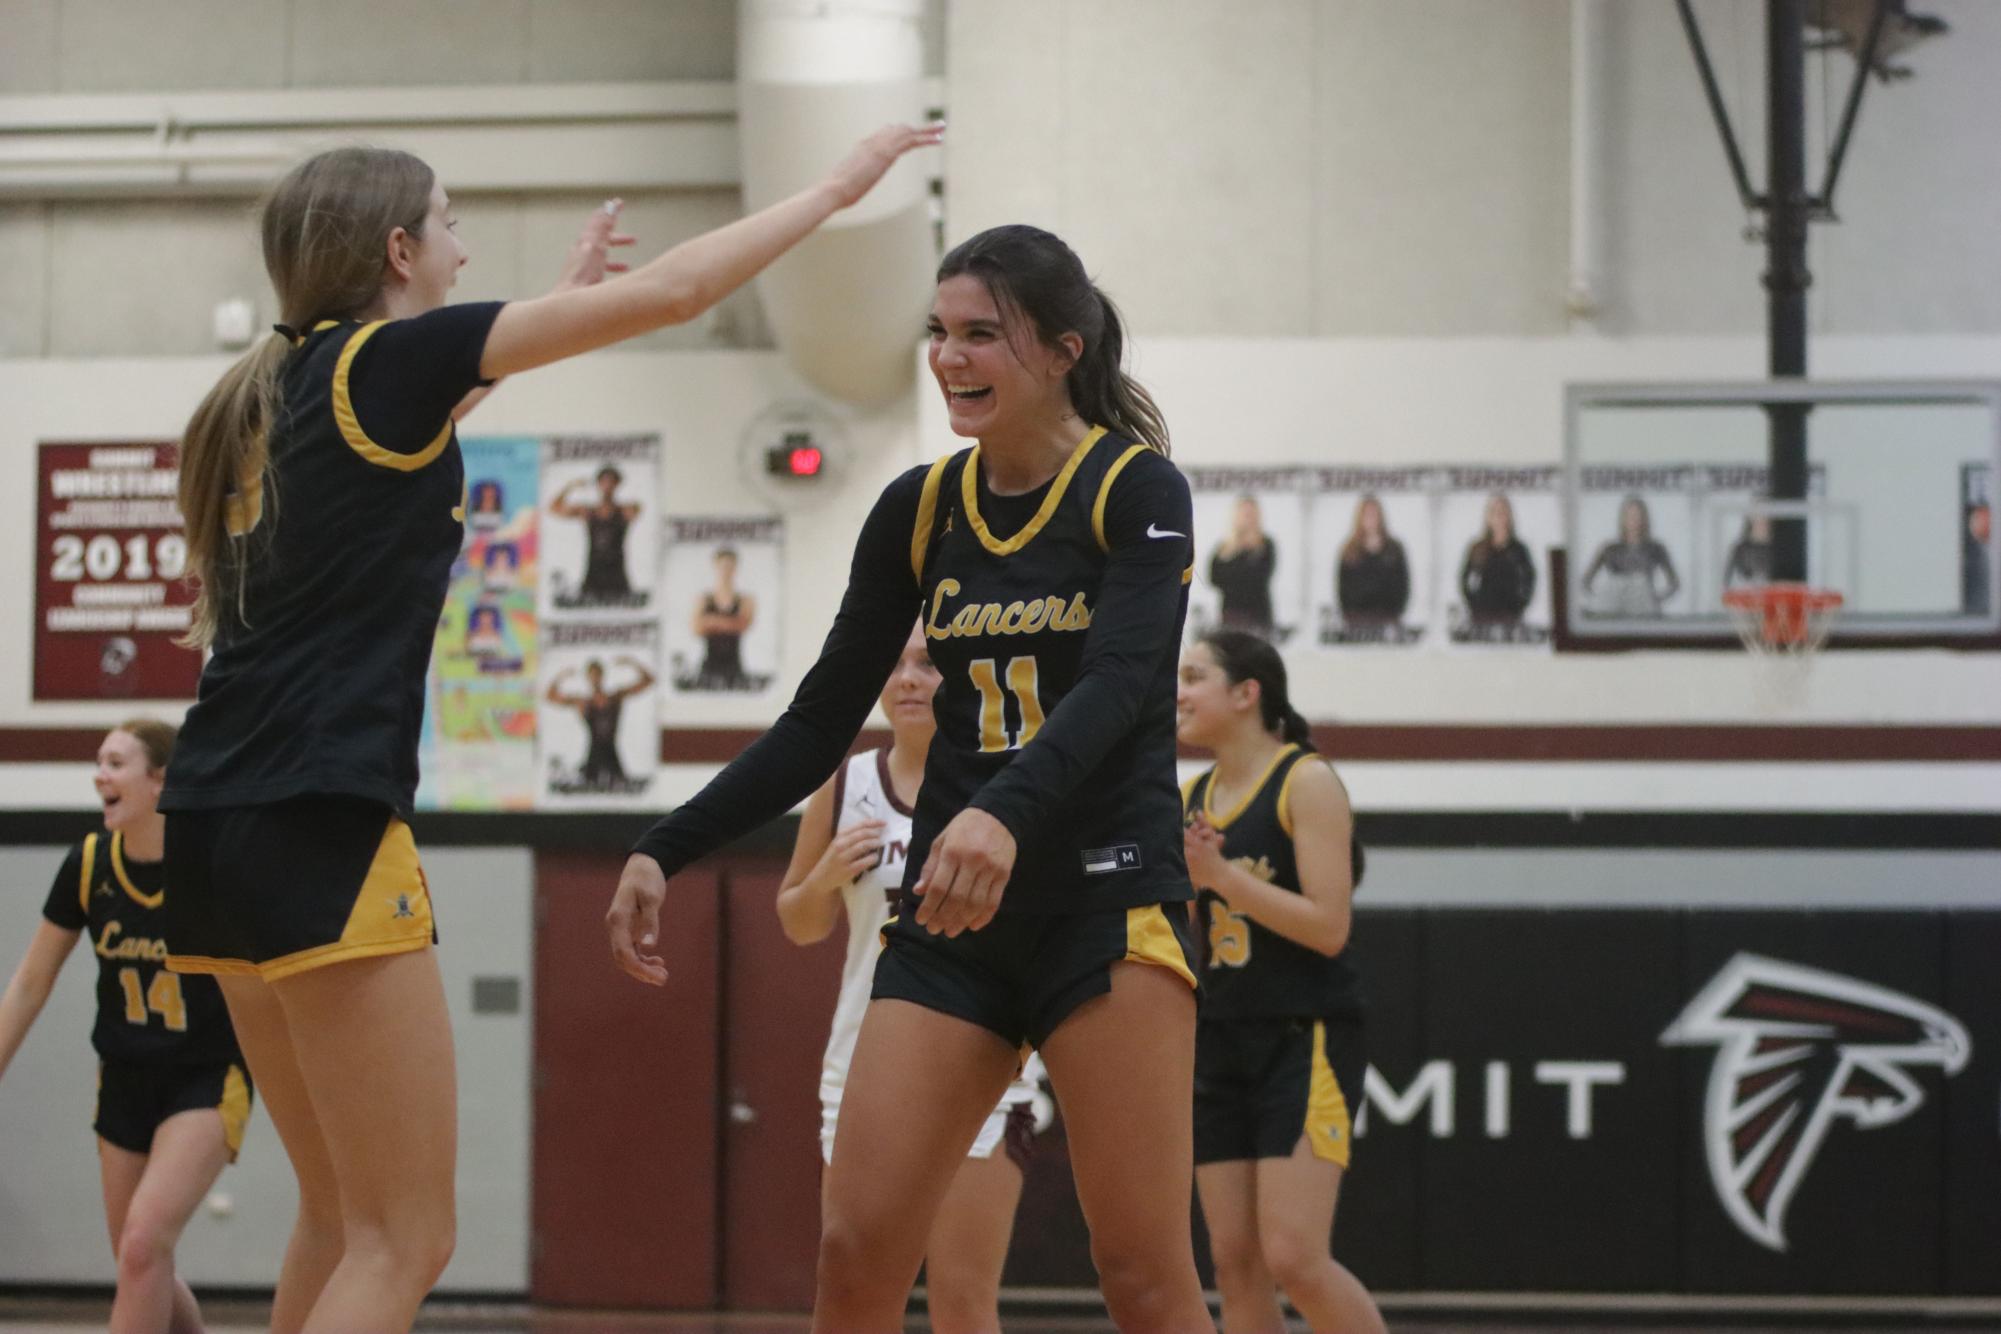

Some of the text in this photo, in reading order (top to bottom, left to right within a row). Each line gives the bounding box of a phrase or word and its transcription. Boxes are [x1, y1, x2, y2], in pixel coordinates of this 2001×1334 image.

[51, 533, 187, 581] 2019
[925, 578, 1094, 640] Lancers
[968, 655, 1046, 753] 11
[1121, 851, 1135, 863] M
[119, 967, 187, 1032] 14
